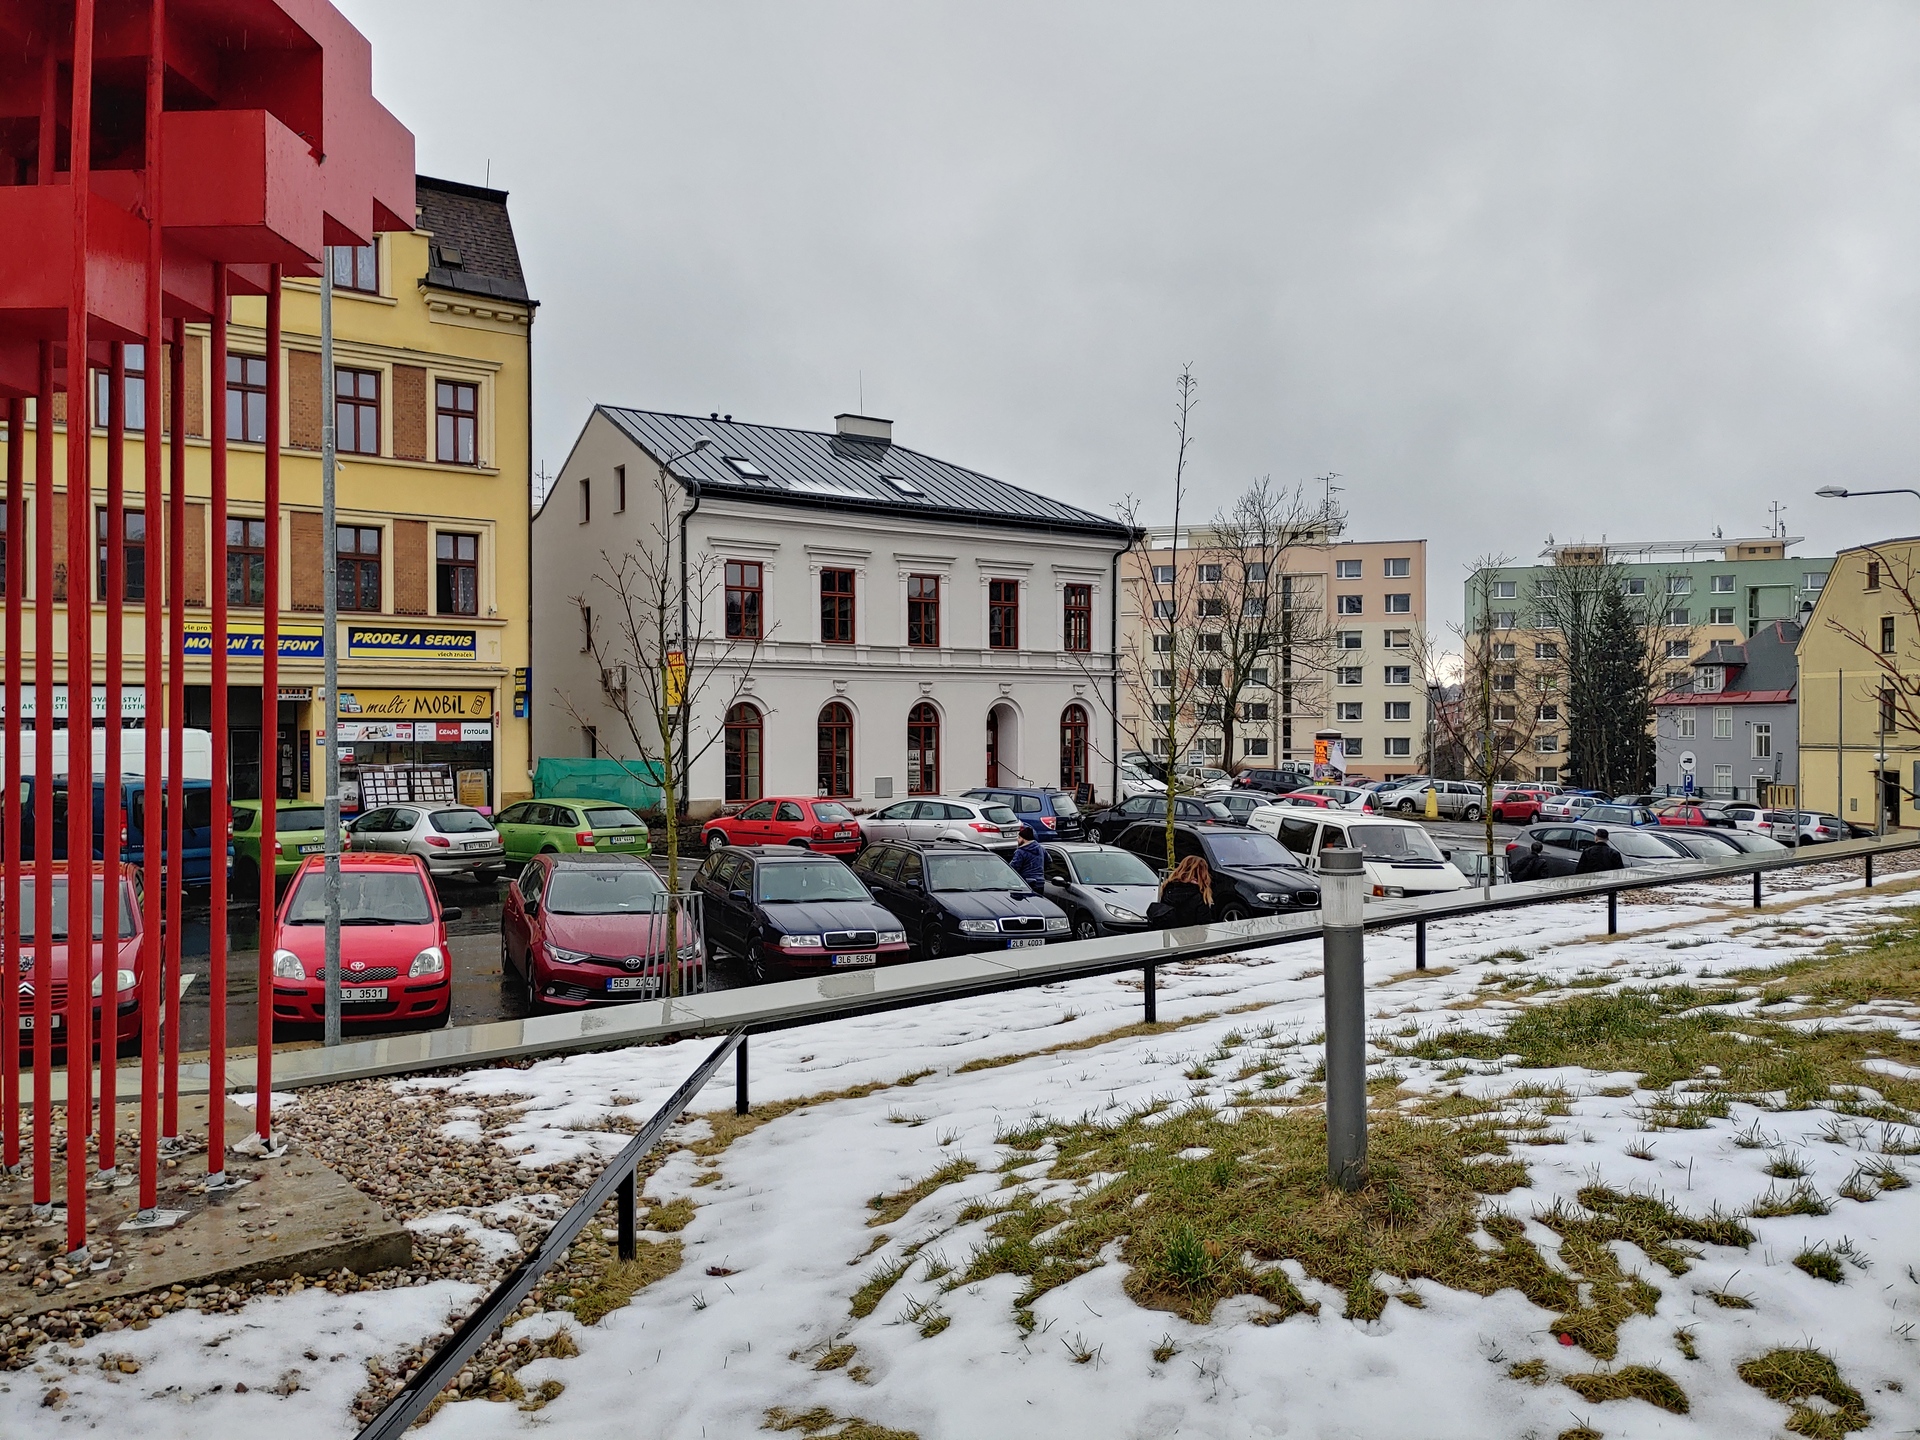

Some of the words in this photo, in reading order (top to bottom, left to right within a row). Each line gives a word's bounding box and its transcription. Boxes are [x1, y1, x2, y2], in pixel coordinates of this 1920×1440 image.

[184, 636, 250, 650] MOLNÍ
[251, 638, 320, 651] TEFONY
[352, 632, 408, 645] PRODEJ
[410, 634, 421, 645] A
[424, 634, 473, 647] SERVIS
[365, 694, 411, 714] multi
[1686, 776, 1692, 786] P
[837, 955, 851, 964] 3L6
[855, 955, 873, 963] 5854
[613, 978, 630, 988] 5E9
[359, 988, 383, 999] 3531
